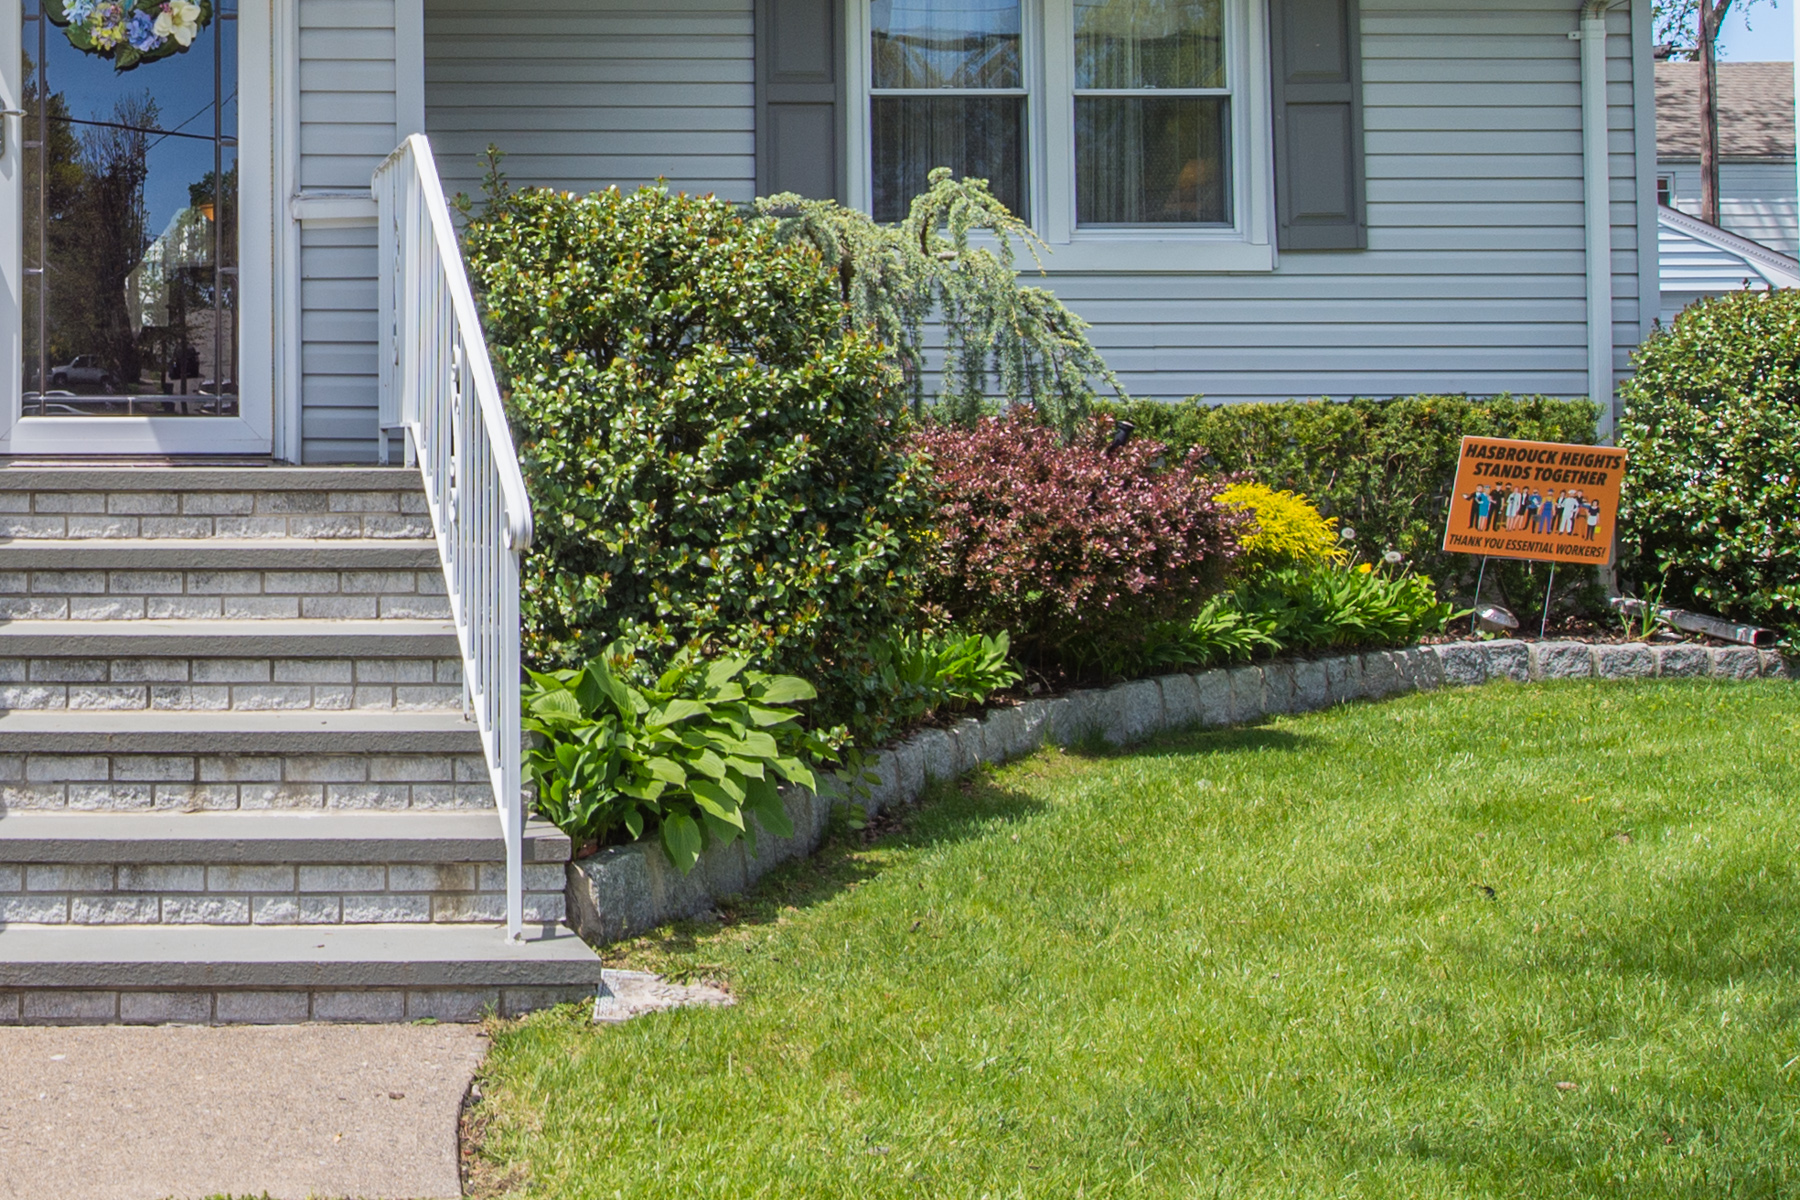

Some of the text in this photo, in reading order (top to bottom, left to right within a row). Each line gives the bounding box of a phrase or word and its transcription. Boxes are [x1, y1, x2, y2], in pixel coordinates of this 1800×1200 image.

[1465, 444, 1622, 469] HASBROUCK HEIGHTS
[1473, 462, 1607, 486] STANDS TOGETHER
[1449, 534, 1606, 558] THANK YOU ESSENTIAL WORKERS!
